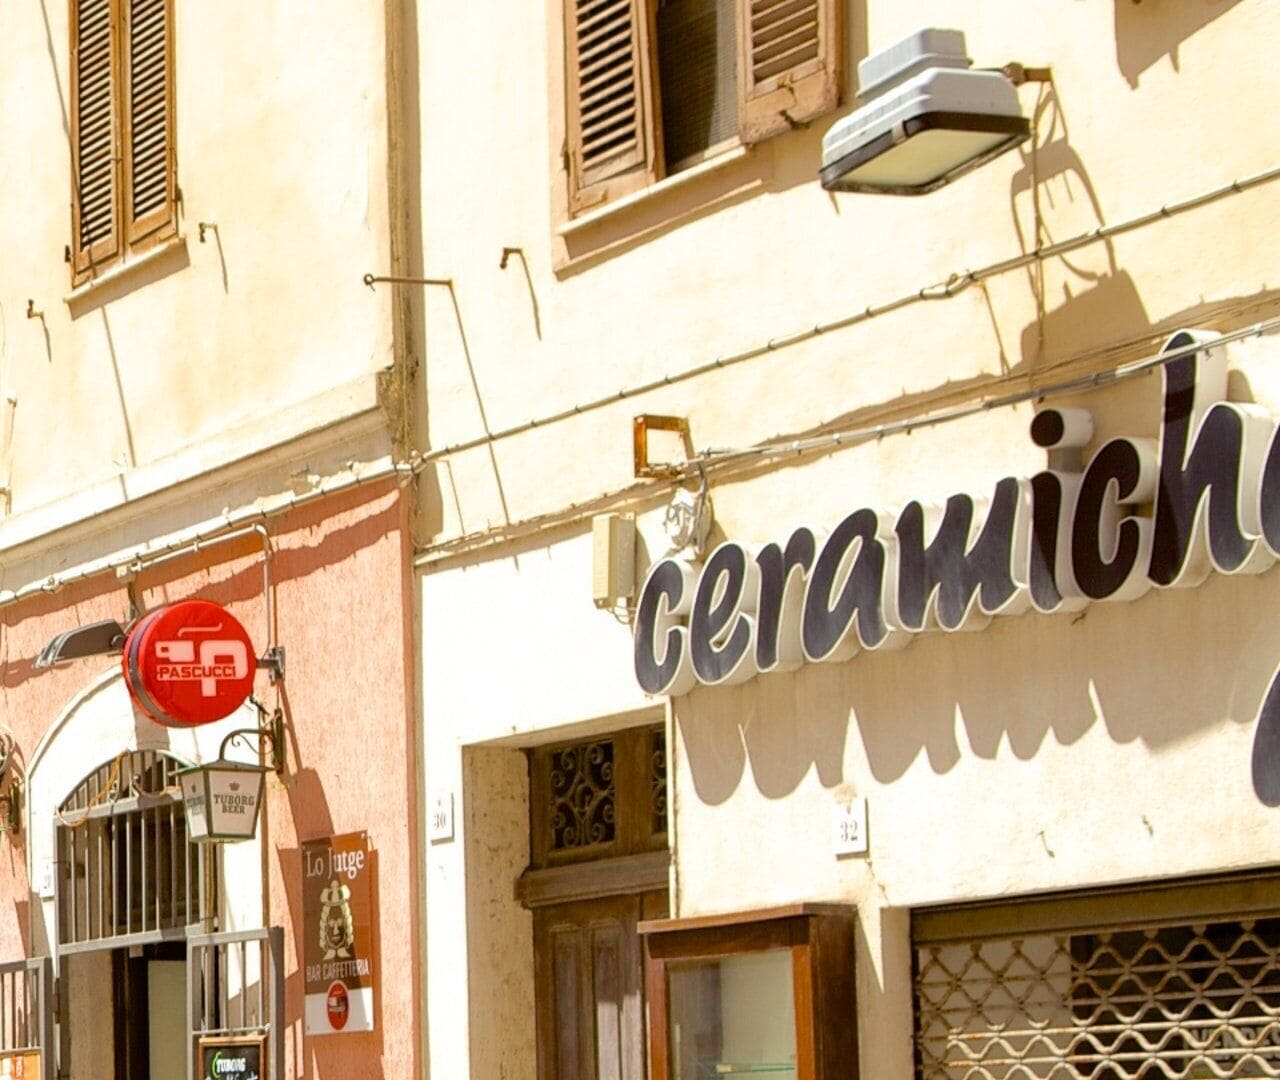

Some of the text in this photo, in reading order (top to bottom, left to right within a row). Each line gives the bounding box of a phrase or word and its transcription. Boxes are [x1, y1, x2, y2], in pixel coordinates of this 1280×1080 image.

[159, 666, 237, 678] PASCUCCI
[214, 794, 255, 806] TUBORG
[222, 805, 245, 814] BEER
[840, 821, 858, 842] 32
[306, 847, 365, 880] Lo Jutge
[307, 958, 370, 982] BAR CAFFETTERIA
